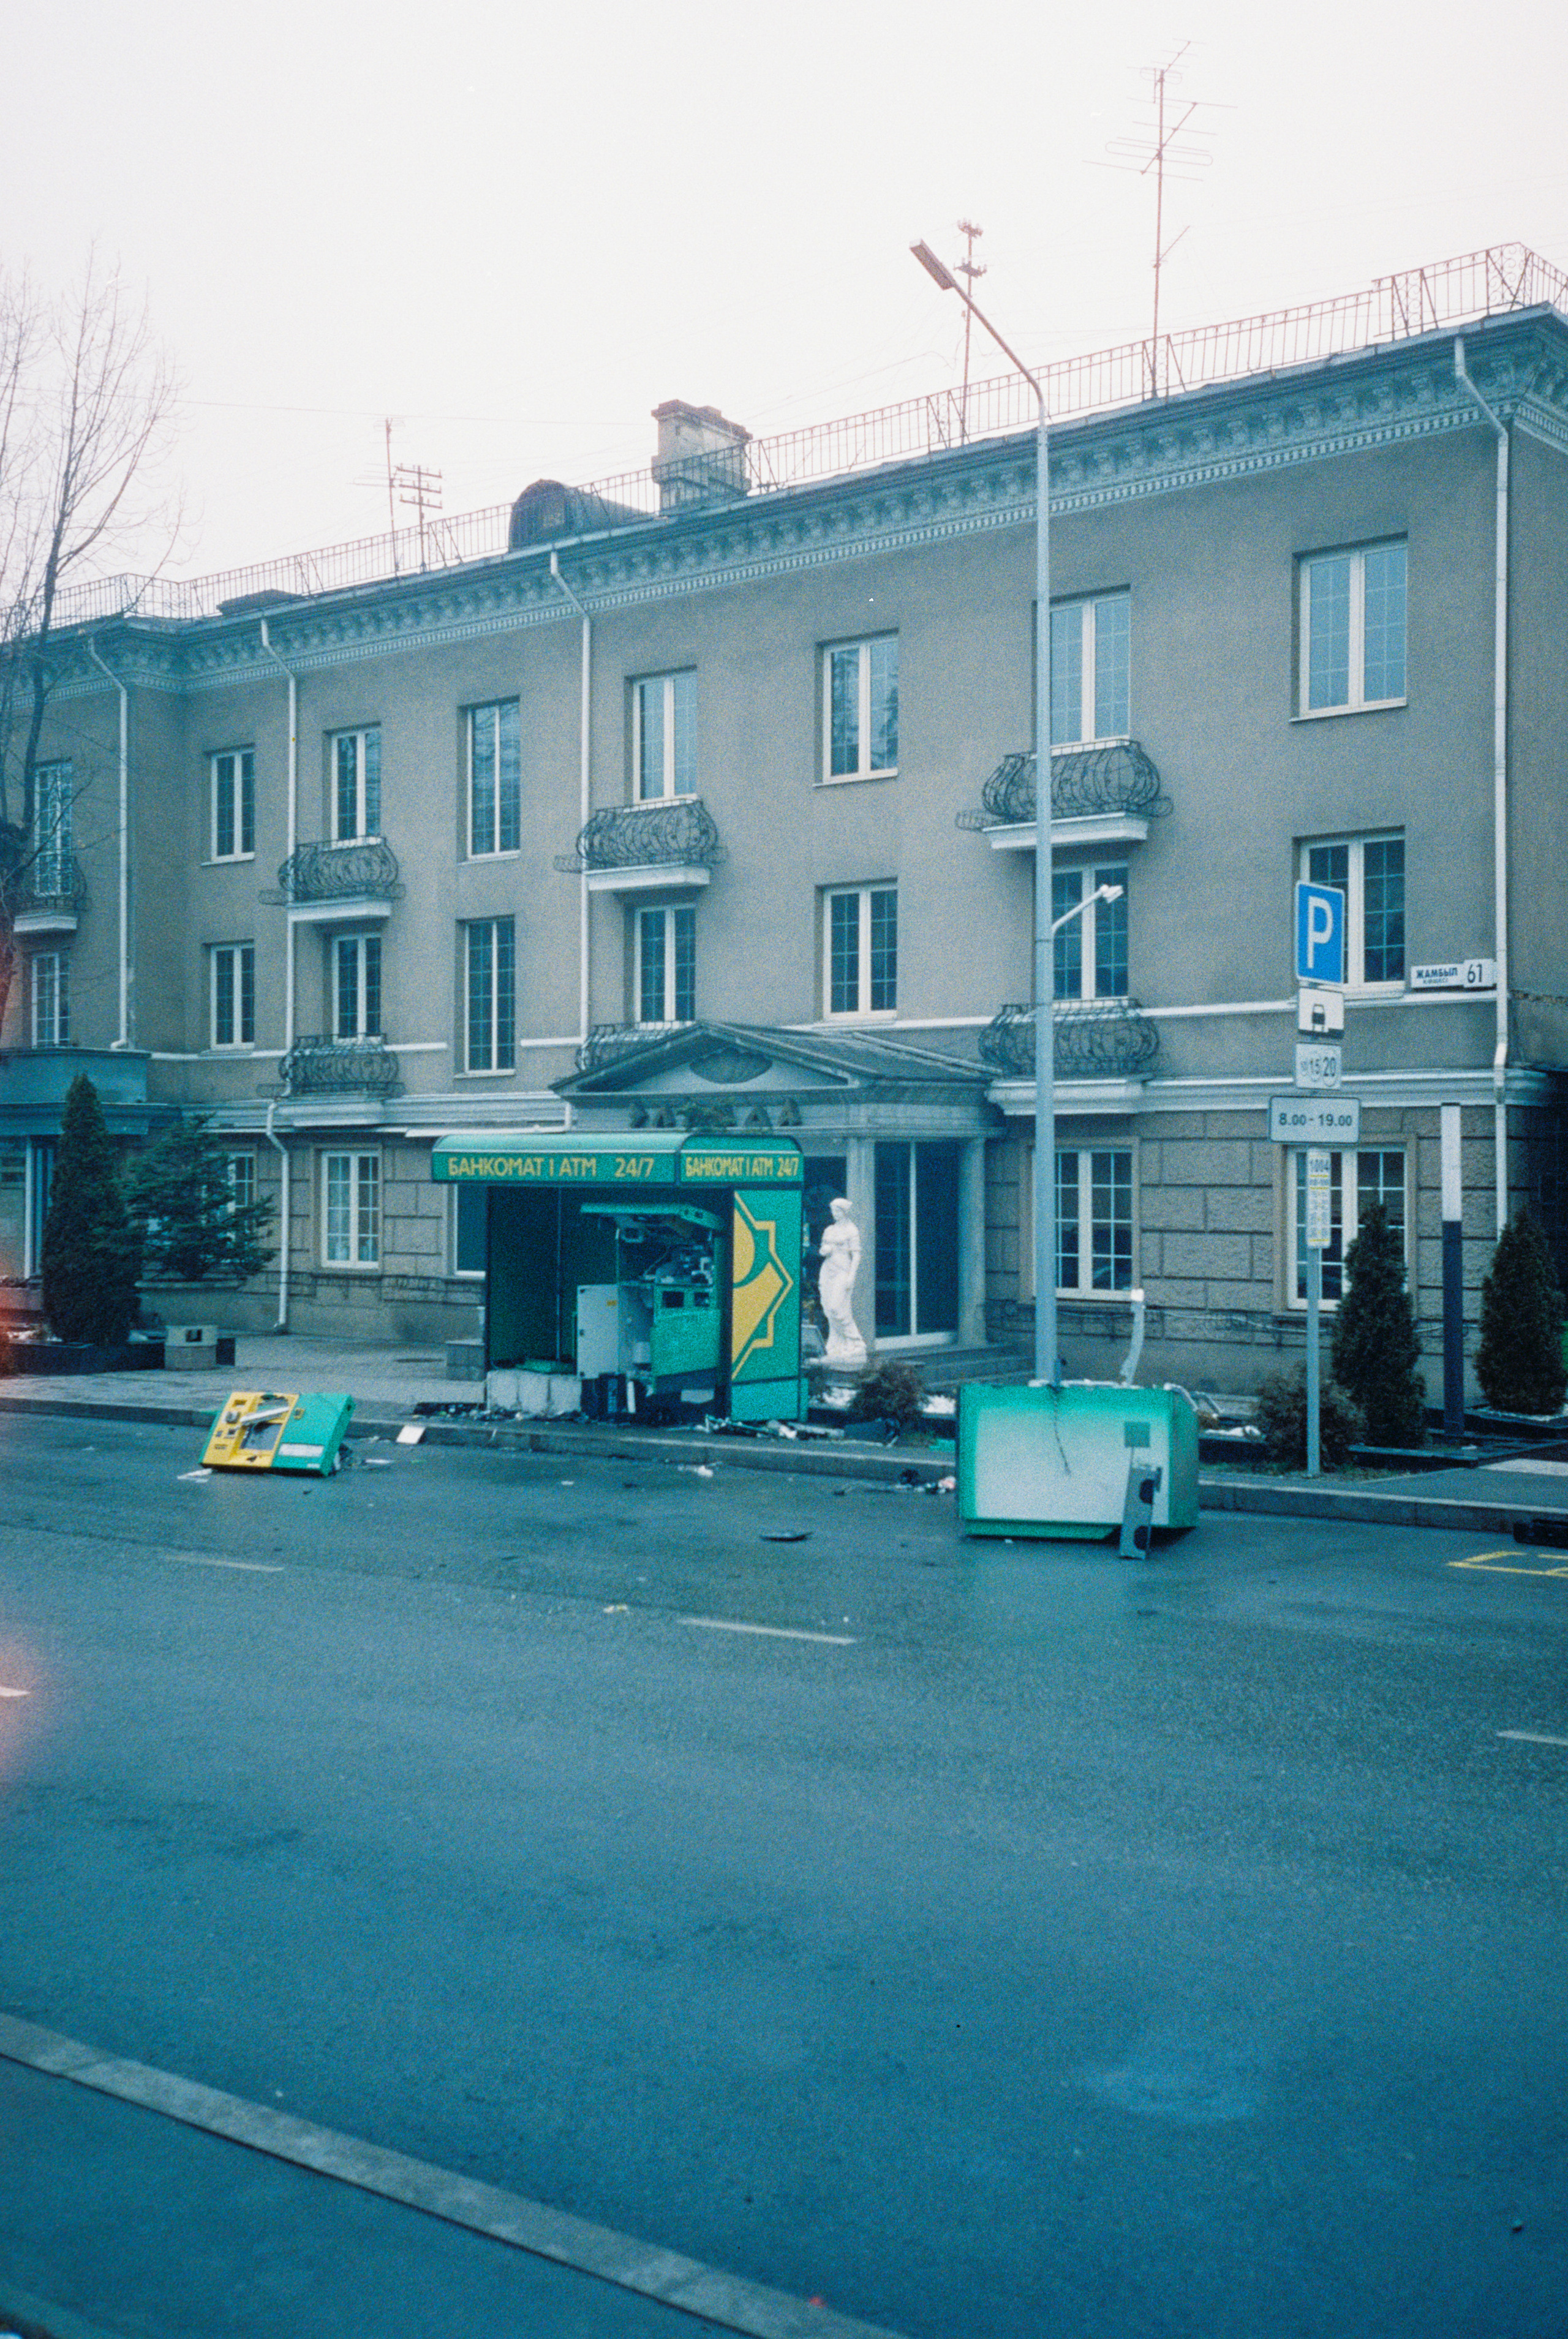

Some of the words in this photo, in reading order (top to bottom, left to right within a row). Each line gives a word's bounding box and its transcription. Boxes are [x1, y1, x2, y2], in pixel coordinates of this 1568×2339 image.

[1307, 895, 1333, 969] P
[1467, 963, 1482, 983] 61
[1323, 1057, 1336, 1077] 20
[448, 1157, 544, 1177] БАНКОМАТ
[559, 1158, 597, 1177] ATM
[614, 1158, 654, 1178] 24/7
[685, 1156, 745, 1177] БАНКОМАТ
[752, 1157, 774, 1177] ATM
[777, 1157, 799, 1177] 24/7
